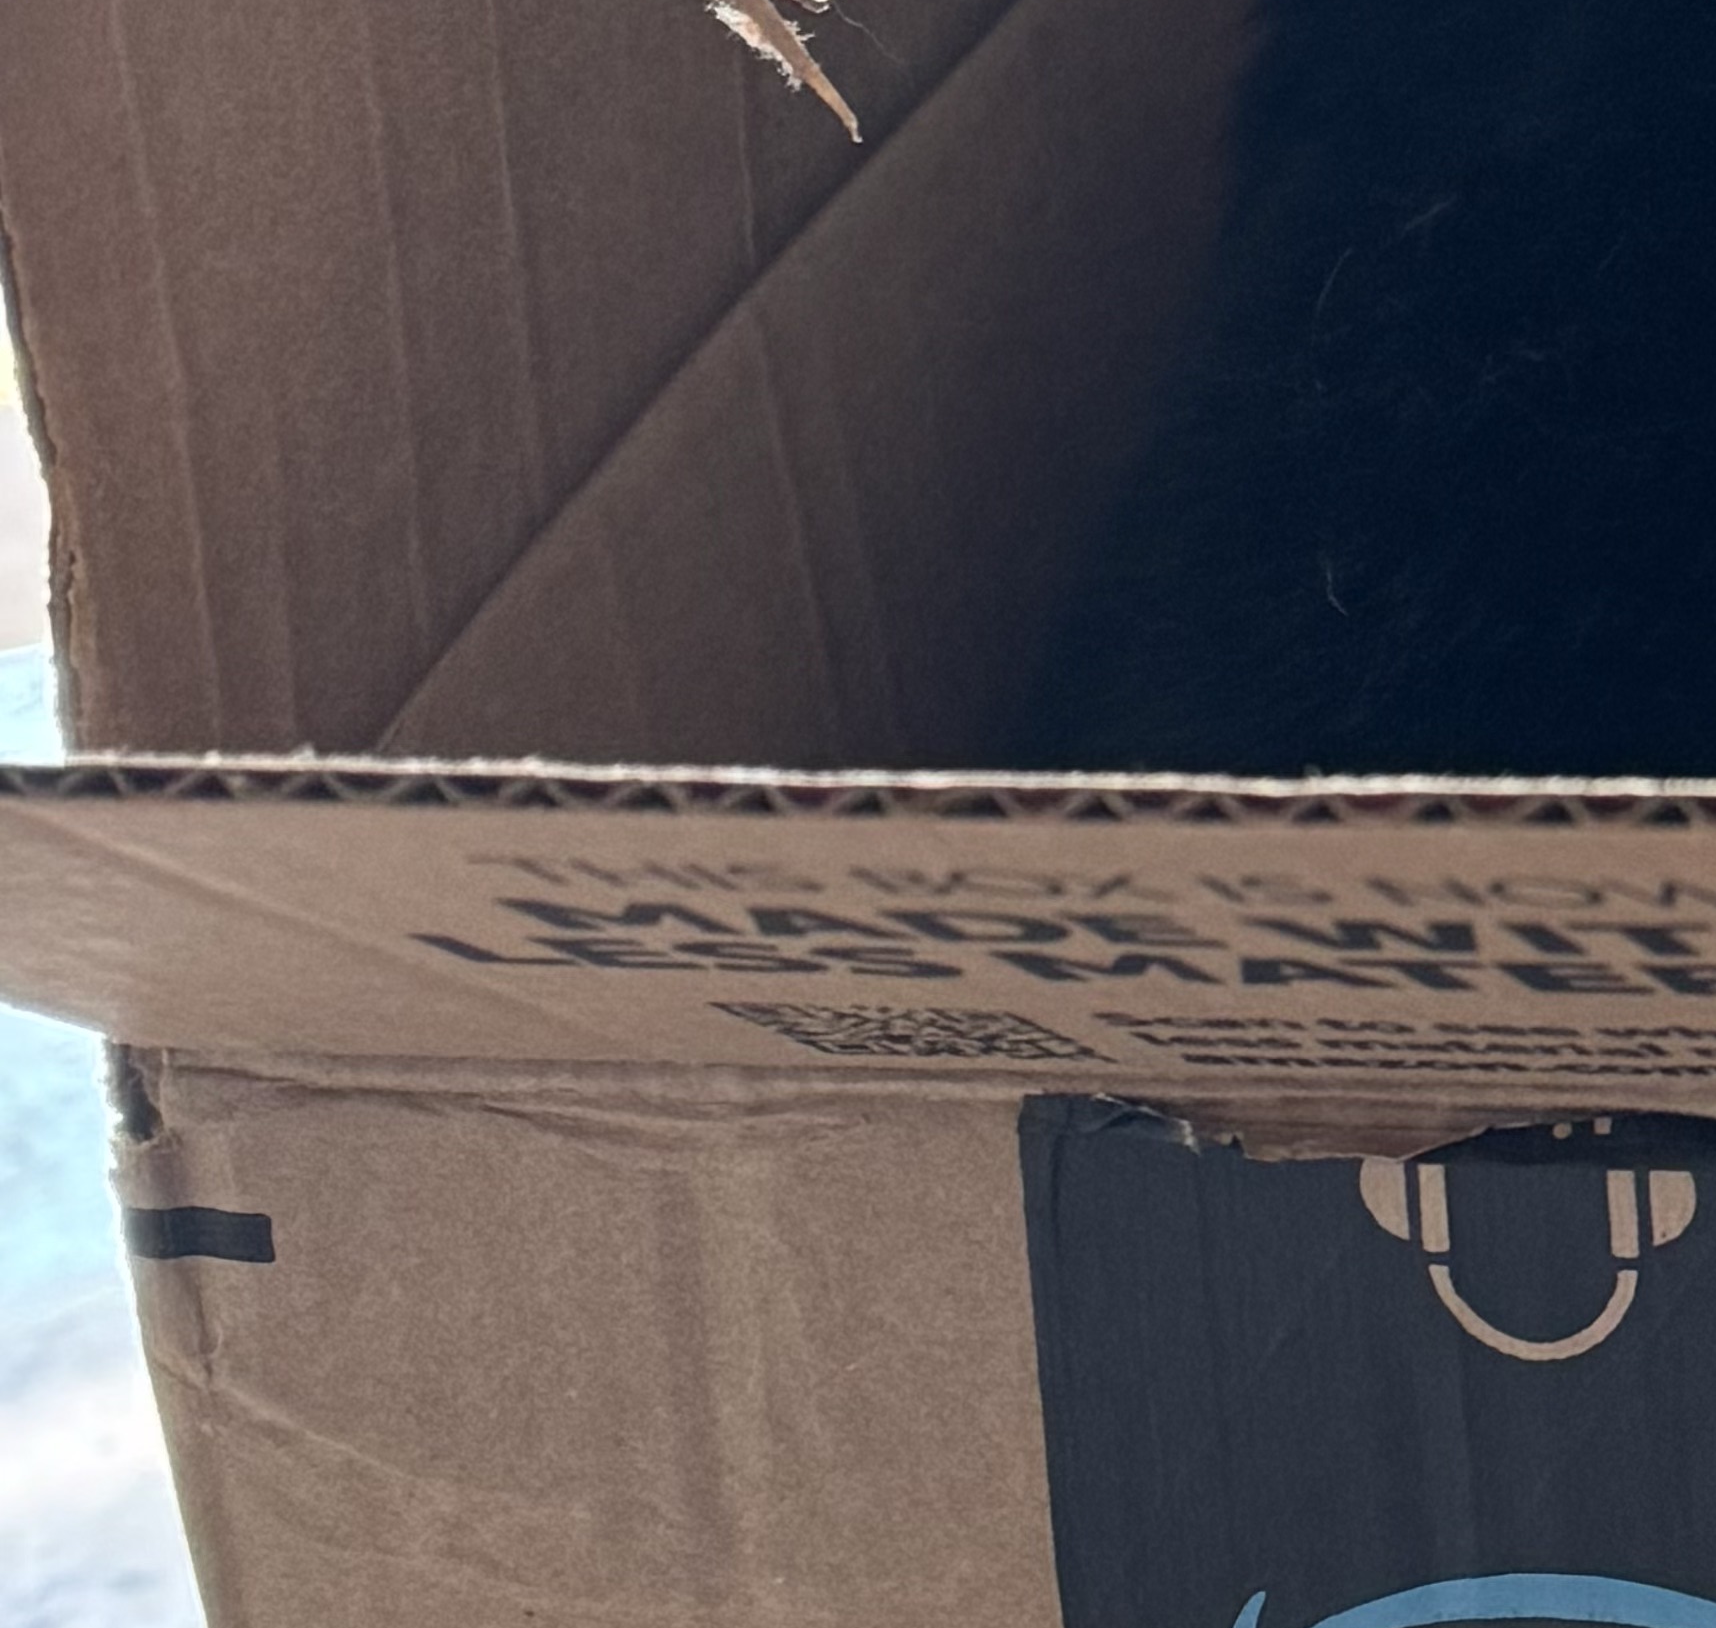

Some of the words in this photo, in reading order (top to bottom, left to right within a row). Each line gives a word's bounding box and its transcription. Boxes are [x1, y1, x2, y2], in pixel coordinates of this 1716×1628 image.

[466, 855, 826, 892] THIS
[496, 897, 1228, 948] MADE
[406, 933, 963, 978] LESS
